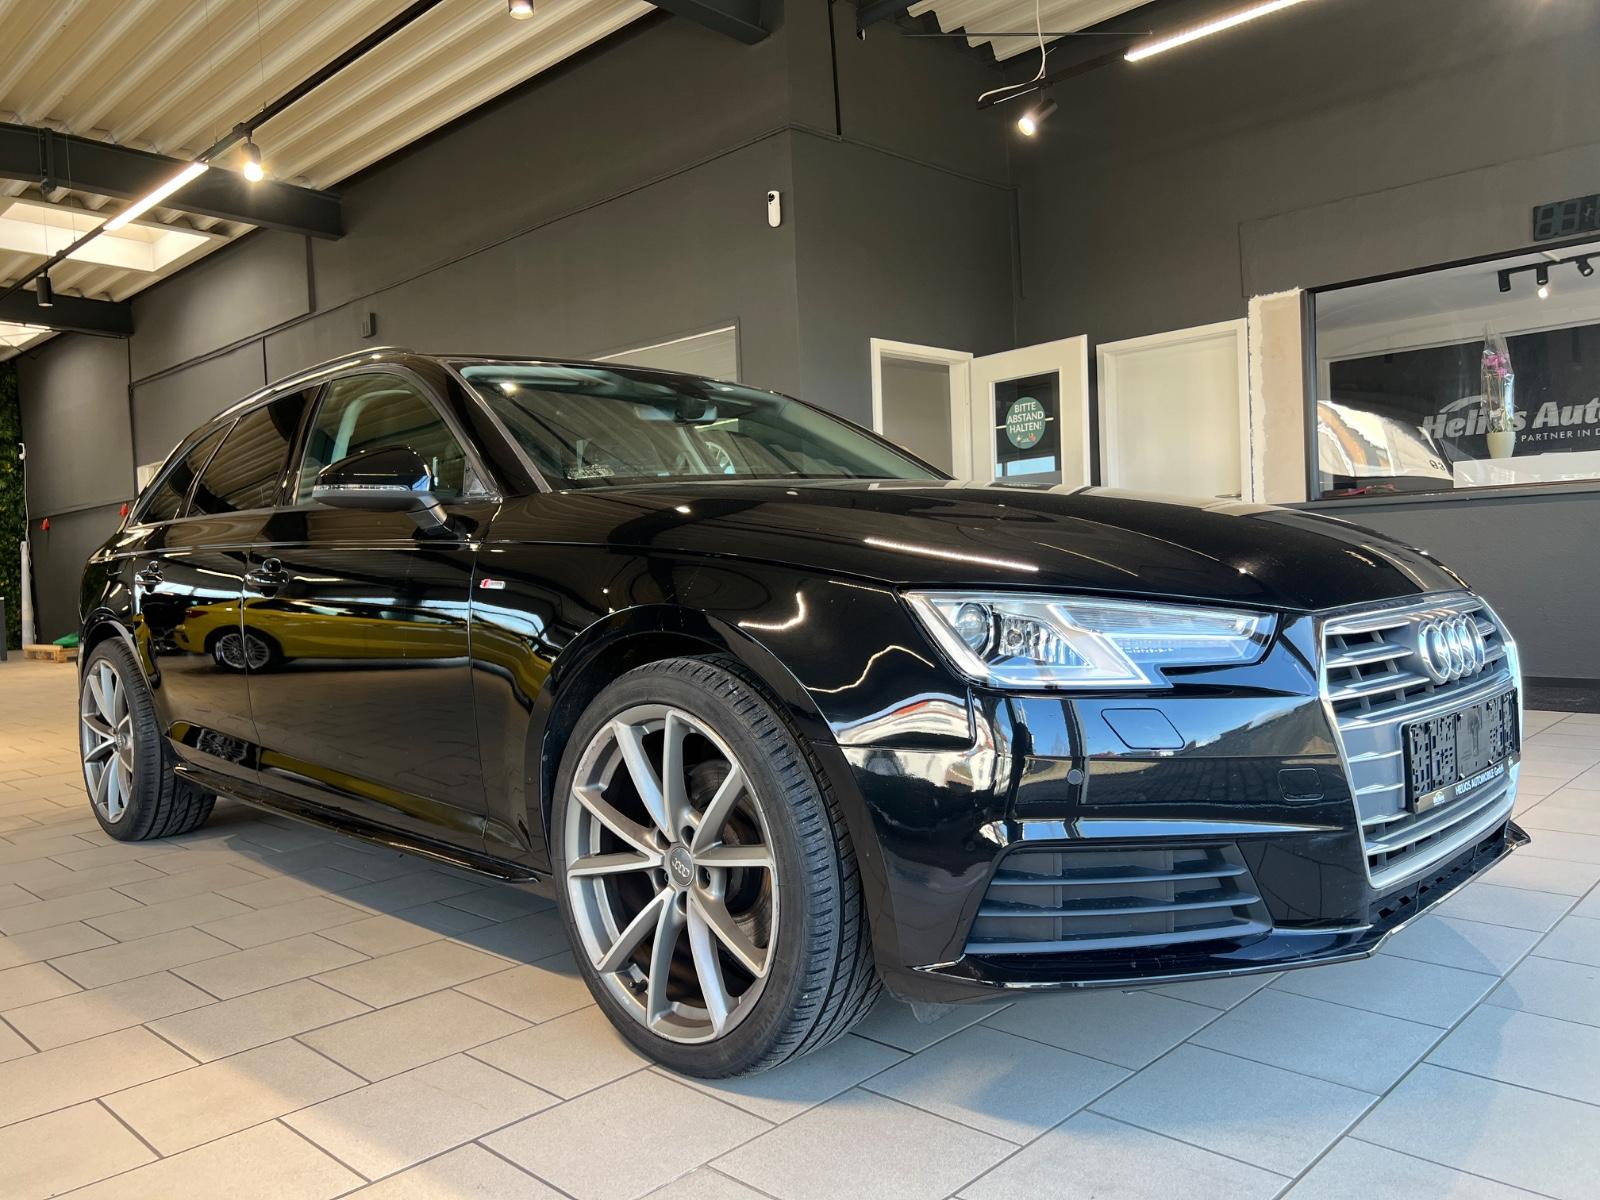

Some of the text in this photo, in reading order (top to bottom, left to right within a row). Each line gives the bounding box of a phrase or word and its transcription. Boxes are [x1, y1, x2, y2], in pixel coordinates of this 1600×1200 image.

[1014, 401, 1036, 413] BITTE
[1007, 411, 1044, 425] ABSTAND
[1421, 397, 1600, 440] Helis Aut
[1009, 421, 1042, 434] HALTEN!
[1521, 430, 1573, 443] PARTNER
[1577, 429, 1591, 438] IN
[1455, 780, 1472, 796] HELIOS
